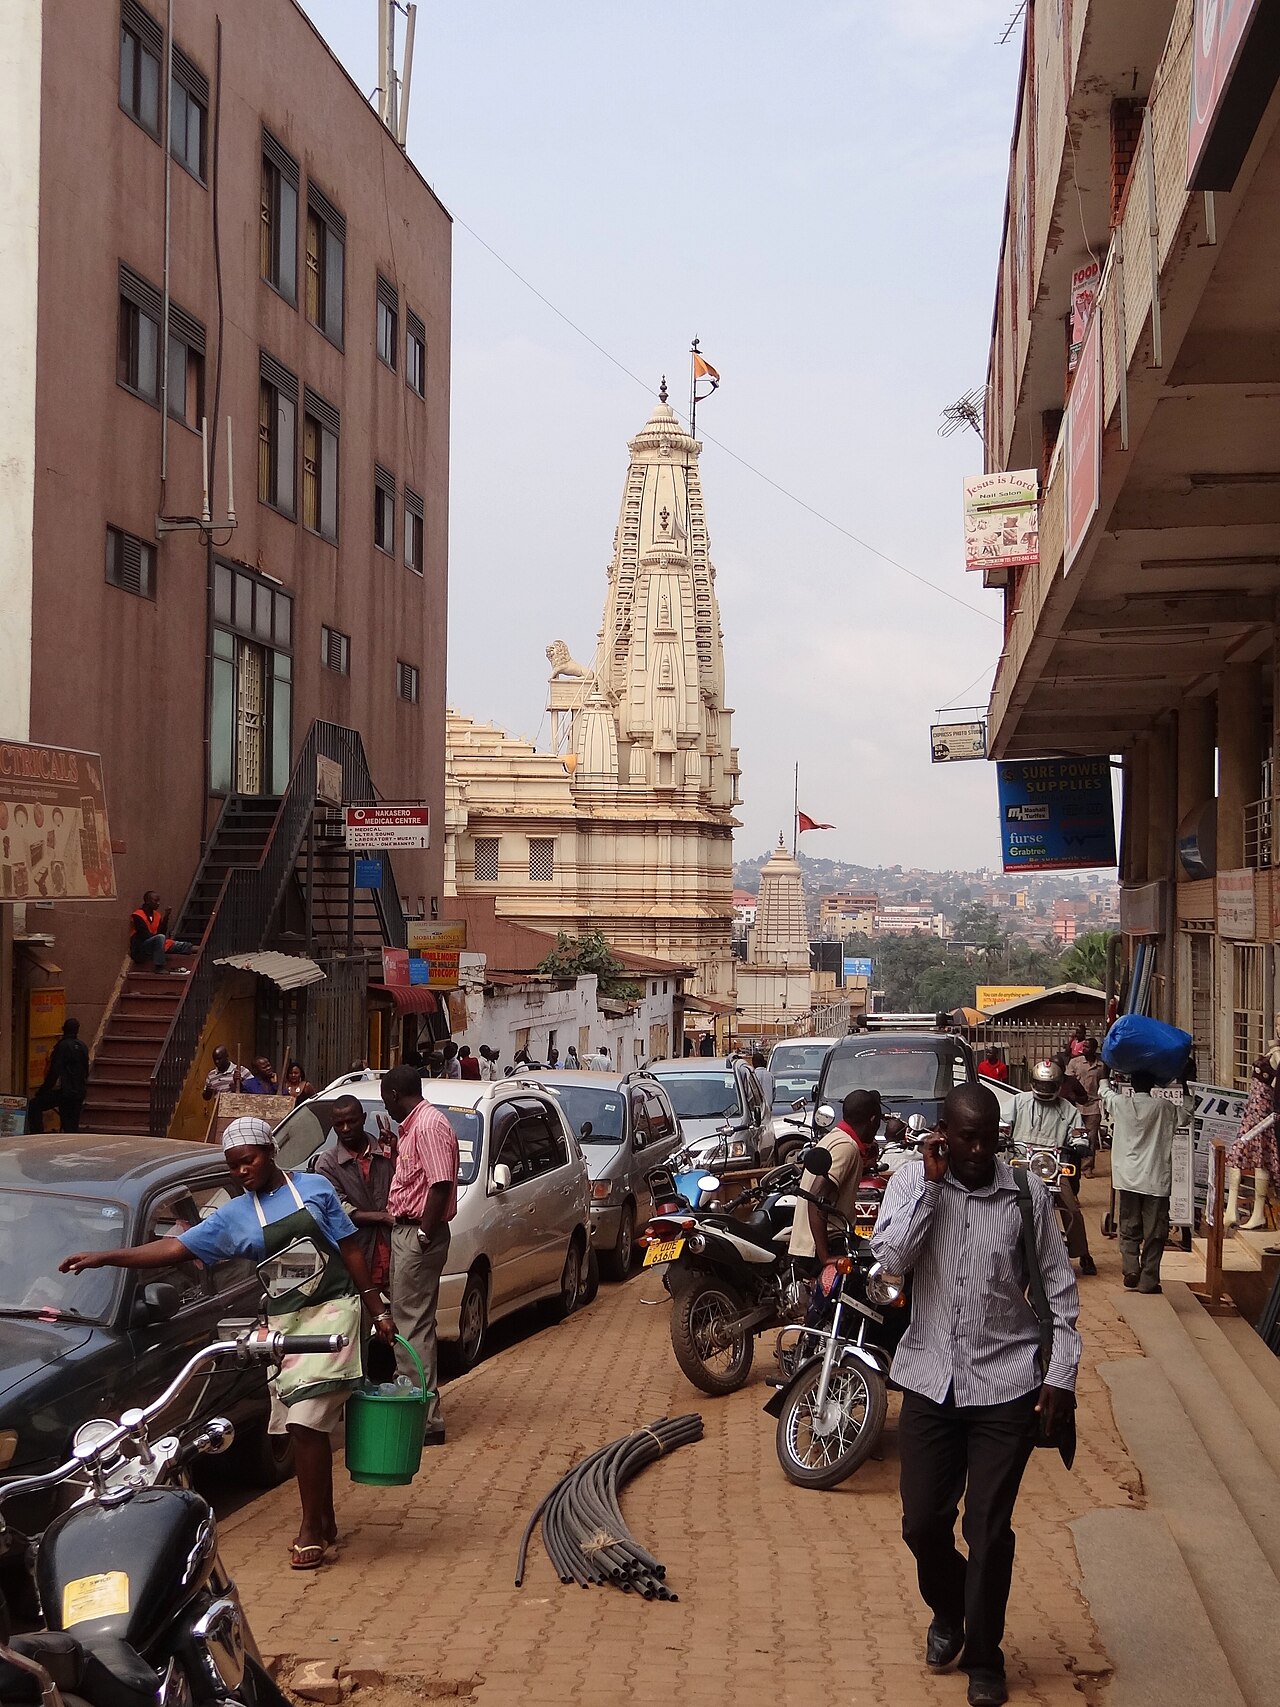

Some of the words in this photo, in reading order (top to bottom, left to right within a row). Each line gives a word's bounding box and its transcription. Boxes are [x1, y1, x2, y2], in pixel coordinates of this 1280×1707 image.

[1074, 263, 1098, 285] FOOD
[966, 478, 995, 497] Jesus
[997, 475, 1007, 484] is
[1009, 474, 1035, 491] Lord
[1022, 765, 1055, 779] SURE
[1060, 763, 1107, 777] POWER
[1026, 780, 1102, 793] SUPPLIES
[364, 817, 393, 825] MEDICAL
[1009, 832, 1043, 844] furse
[660, 1242, 677, 1252] UDE
[652, 1251, 675, 1262] 616R
